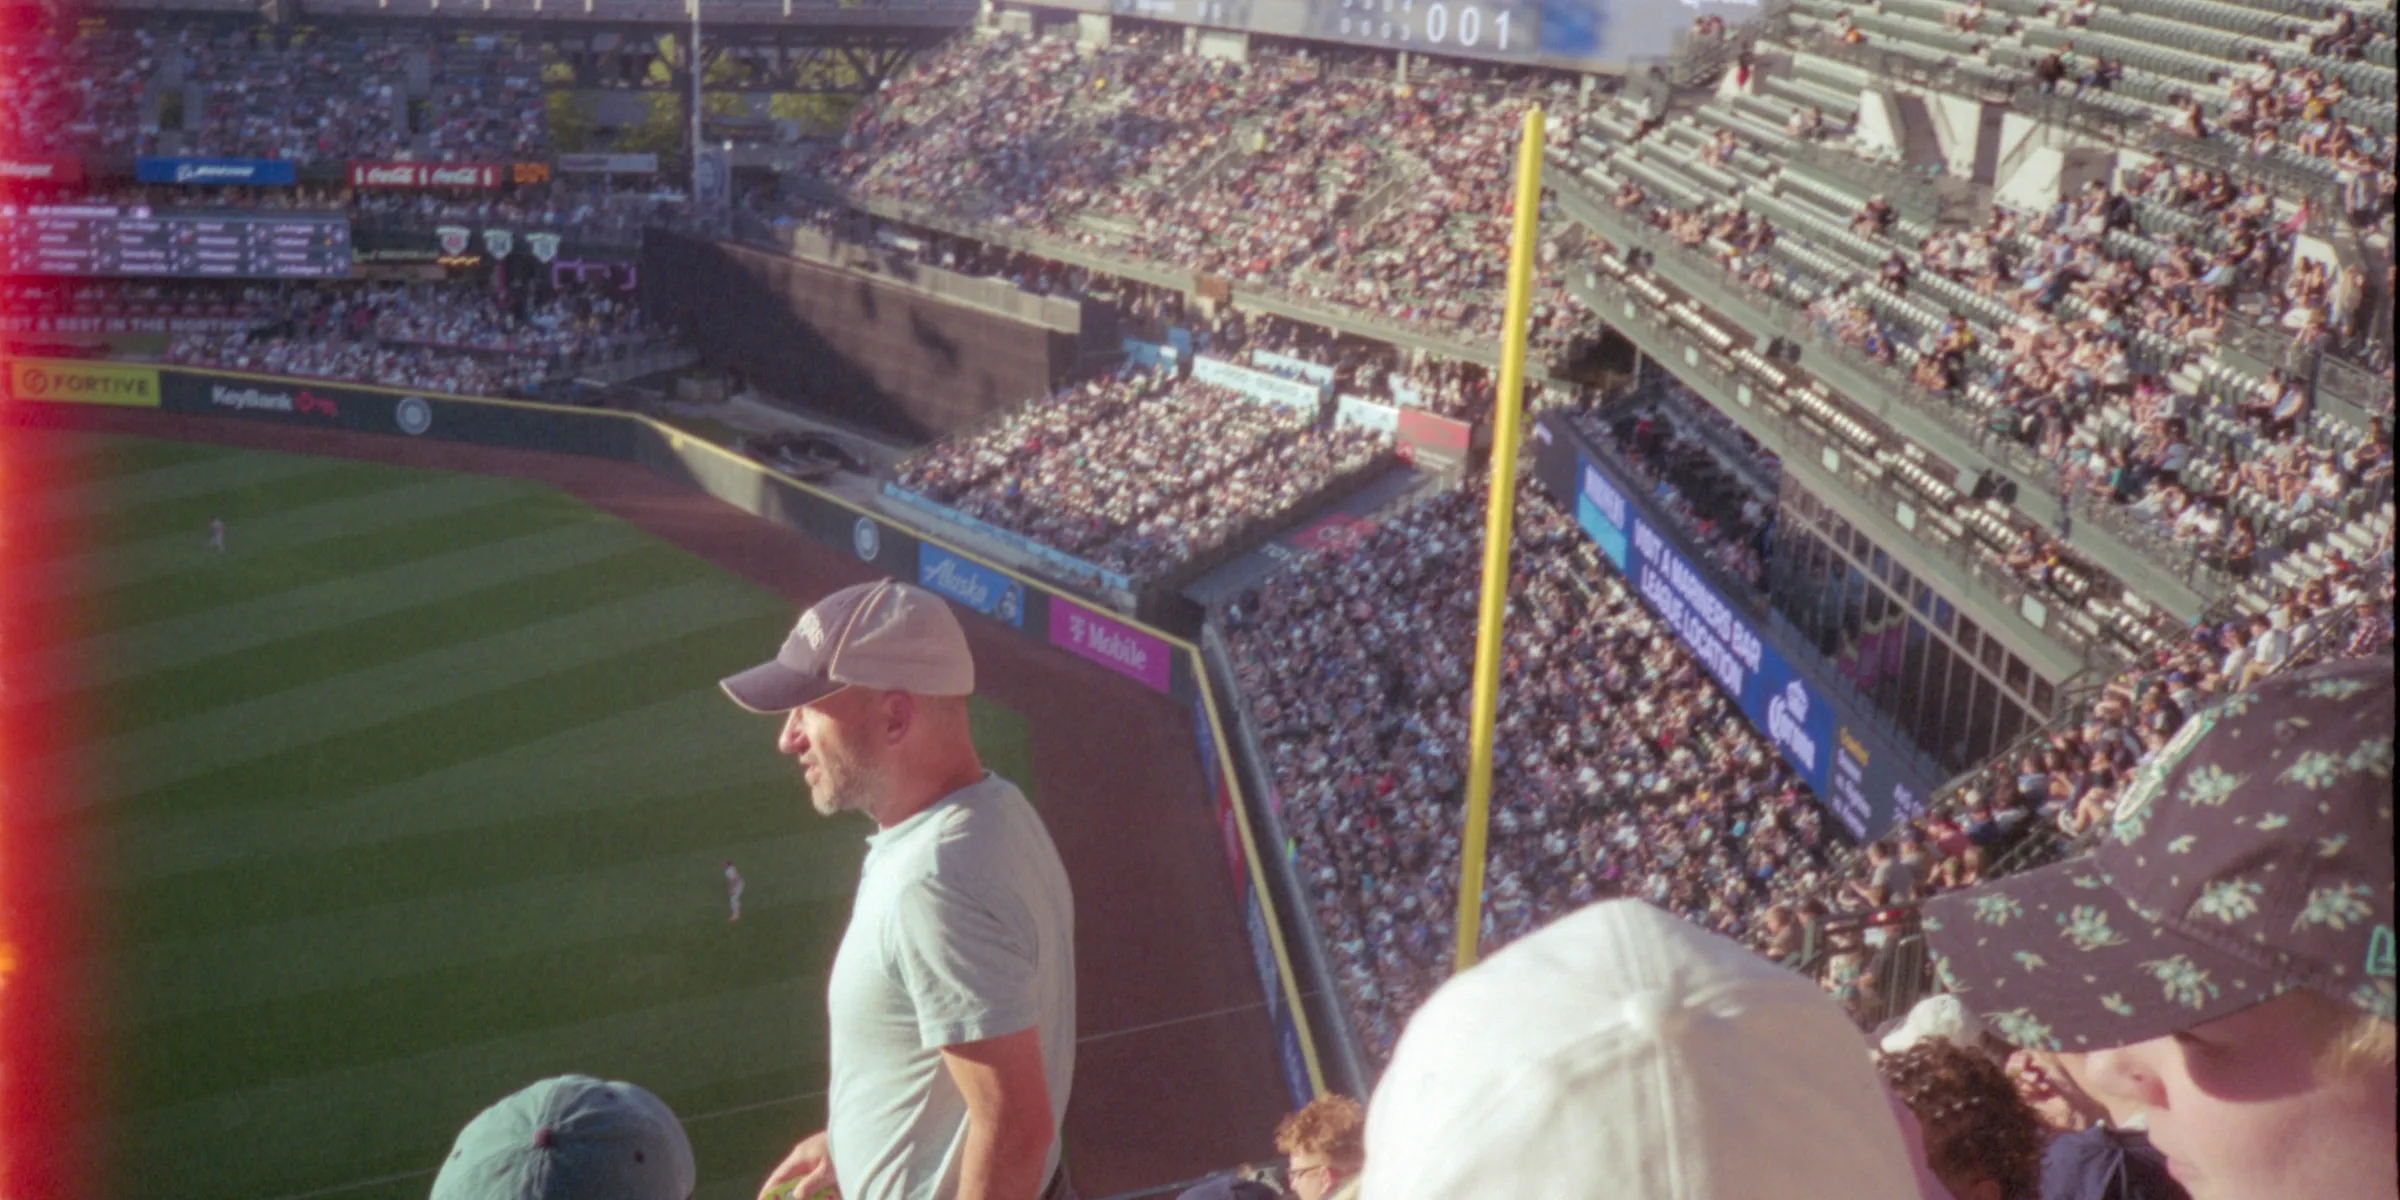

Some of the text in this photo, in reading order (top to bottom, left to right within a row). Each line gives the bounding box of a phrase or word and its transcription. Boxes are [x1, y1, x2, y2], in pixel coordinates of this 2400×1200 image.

[53, 372, 149, 397] FORTIVE
[211, 384, 293, 411] KeyBank
[923, 557, 989, 606] Alaska
[1641, 563, 1744, 697] LEAGUE LOCATION
[1671, 556, 1733, 643] MARINERS
[1731, 619, 1762, 675] BAR
[1088, 621, 1147, 671] Mobile
